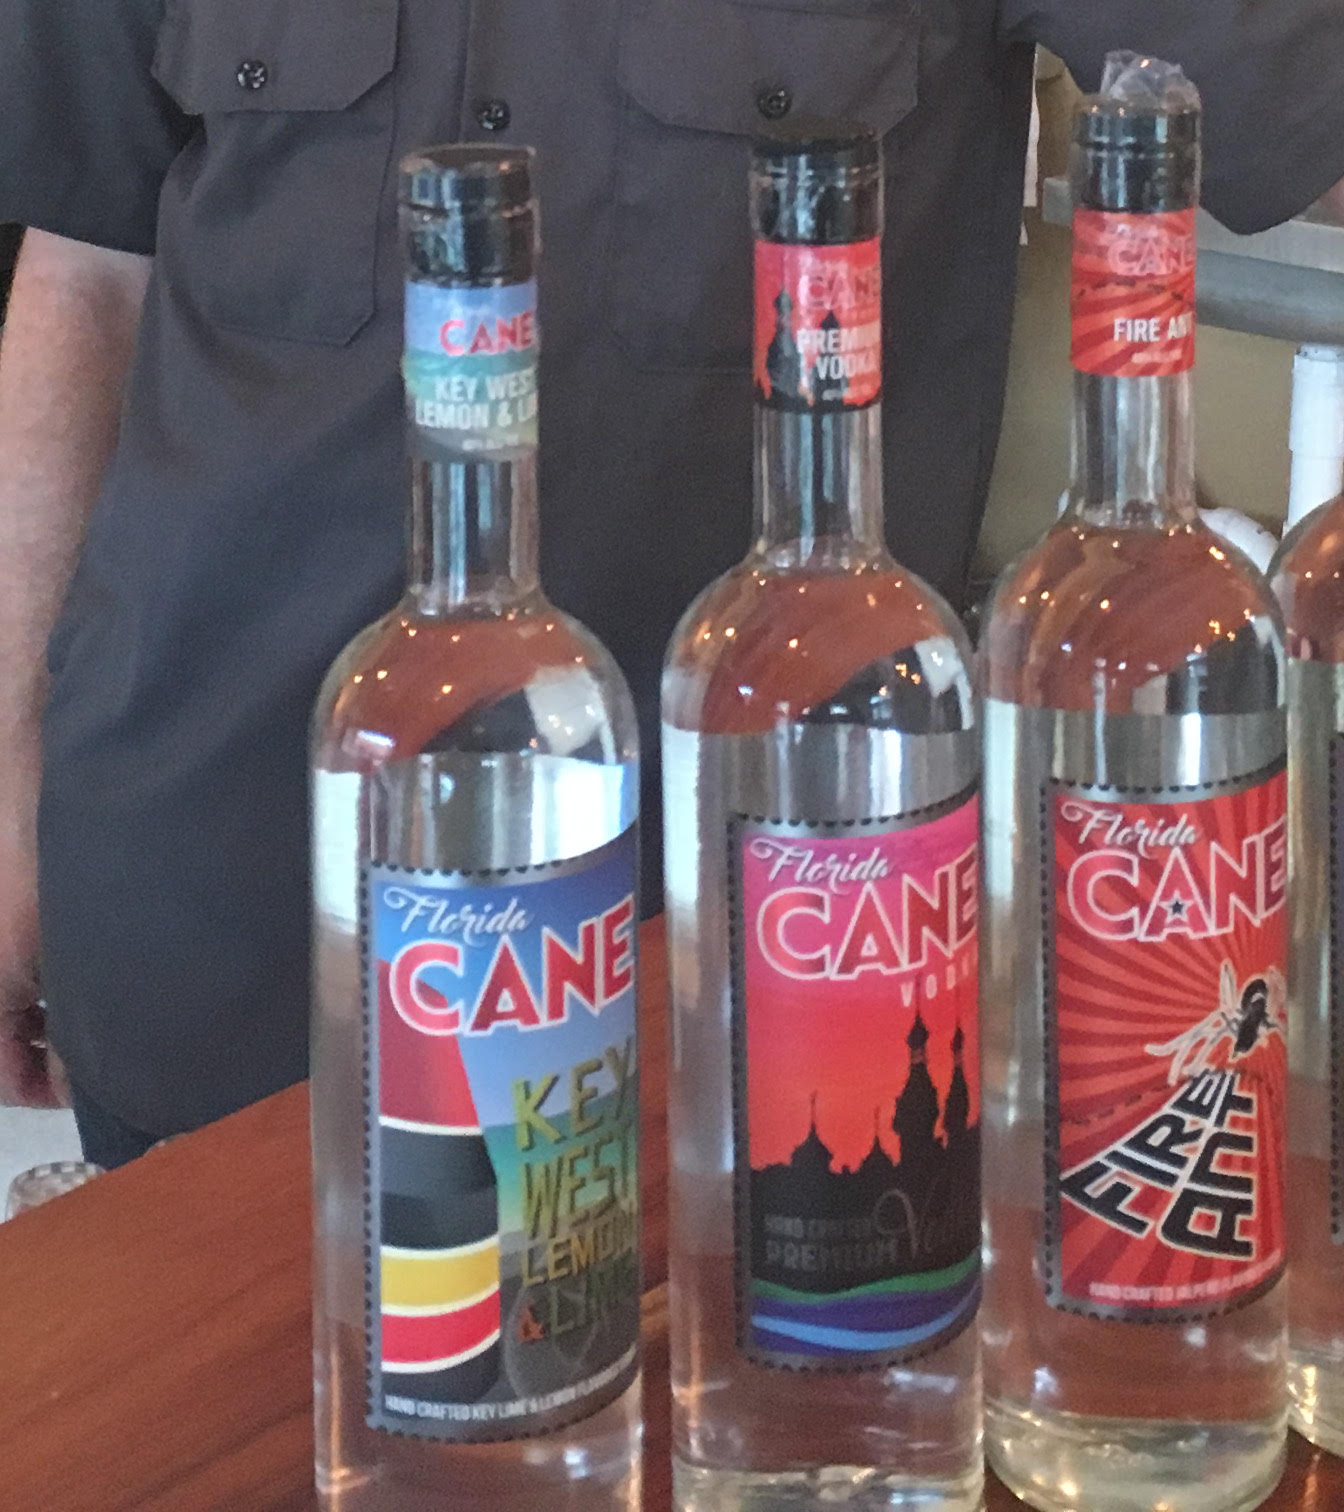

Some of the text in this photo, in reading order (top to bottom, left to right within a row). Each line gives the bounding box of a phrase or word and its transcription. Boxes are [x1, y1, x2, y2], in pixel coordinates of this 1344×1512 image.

[1113, 317, 1161, 343] FIRE
[415, 399, 491, 430] LEMON
[497, 401, 514, 428] &
[435, 373, 478, 401] KEY
[1061, 801, 1202, 860] Florida
[750, 838, 893, 896] Florida
[1067, 814, 1287, 943] CANE
[383, 887, 535, 947] Florida
[757, 841, 978, 980] CANE
[389, 893, 636, 1037] CANE
[512, 1036, 636, 1152] KEY
[1059, 1068, 1215, 1237] FIRE
[1160, 1068, 1256, 1257] ANT
